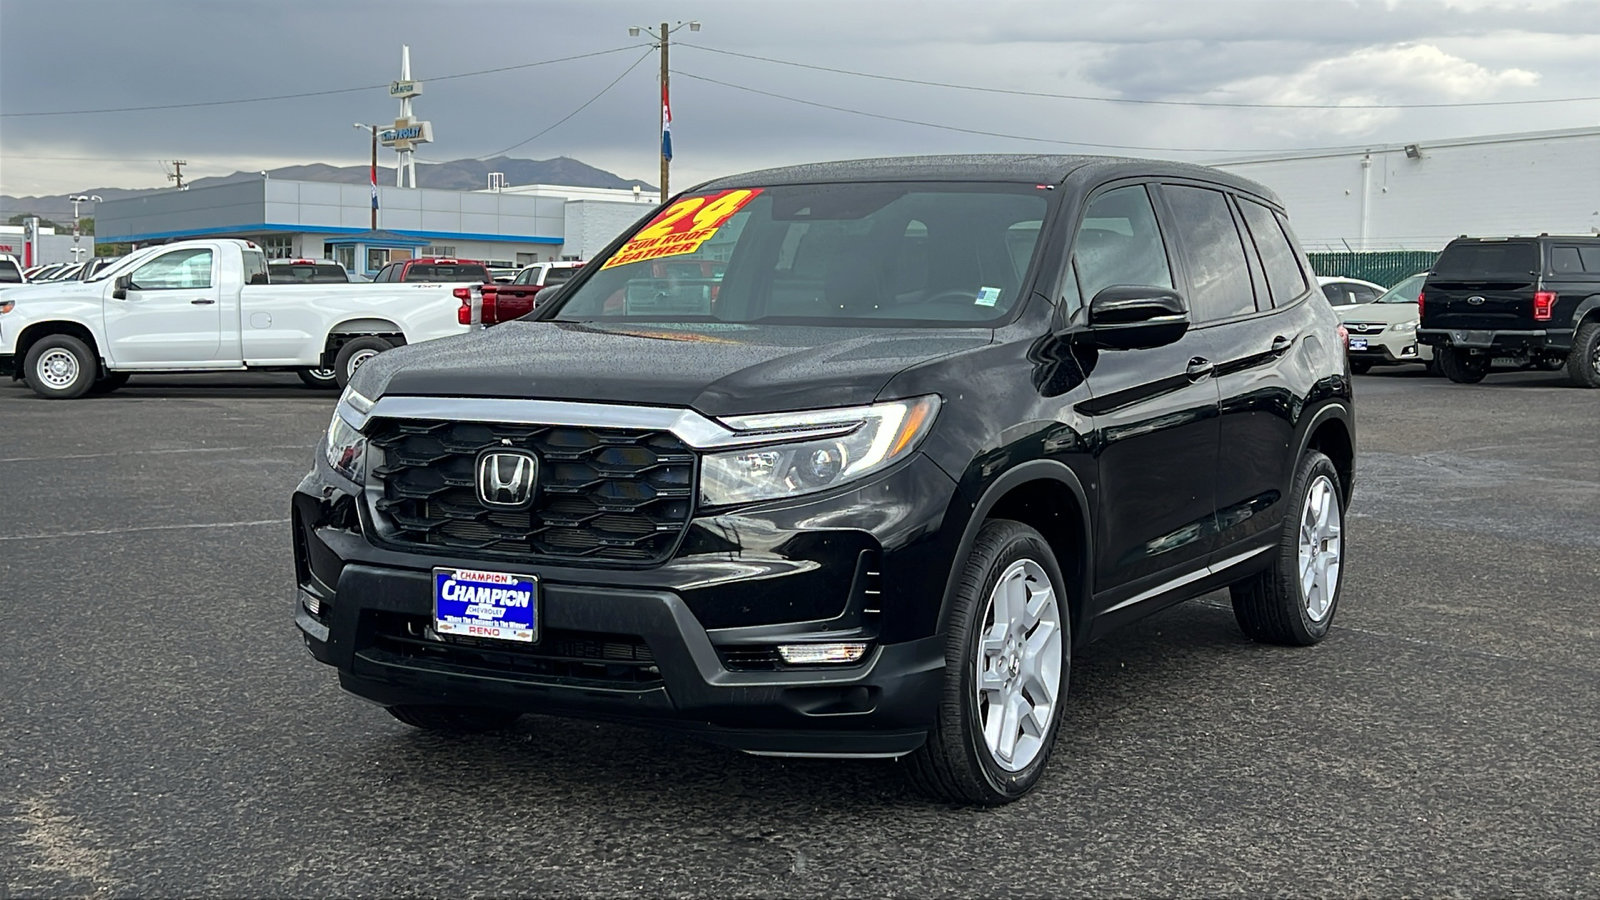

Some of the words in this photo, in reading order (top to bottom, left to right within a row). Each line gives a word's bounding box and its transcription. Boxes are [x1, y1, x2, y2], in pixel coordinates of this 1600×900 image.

[634, 189, 752, 241] 24
[623, 237, 659, 253] SUN
[663, 229, 713, 245] ROOF
[605, 242, 698, 267] LEATHER
[460, 571, 508, 583] CHAMPION
[441, 579, 531, 608] CHAMPION
[468, 606, 503, 616] CHEVROLET
[469, 626, 500, 637] RENO
